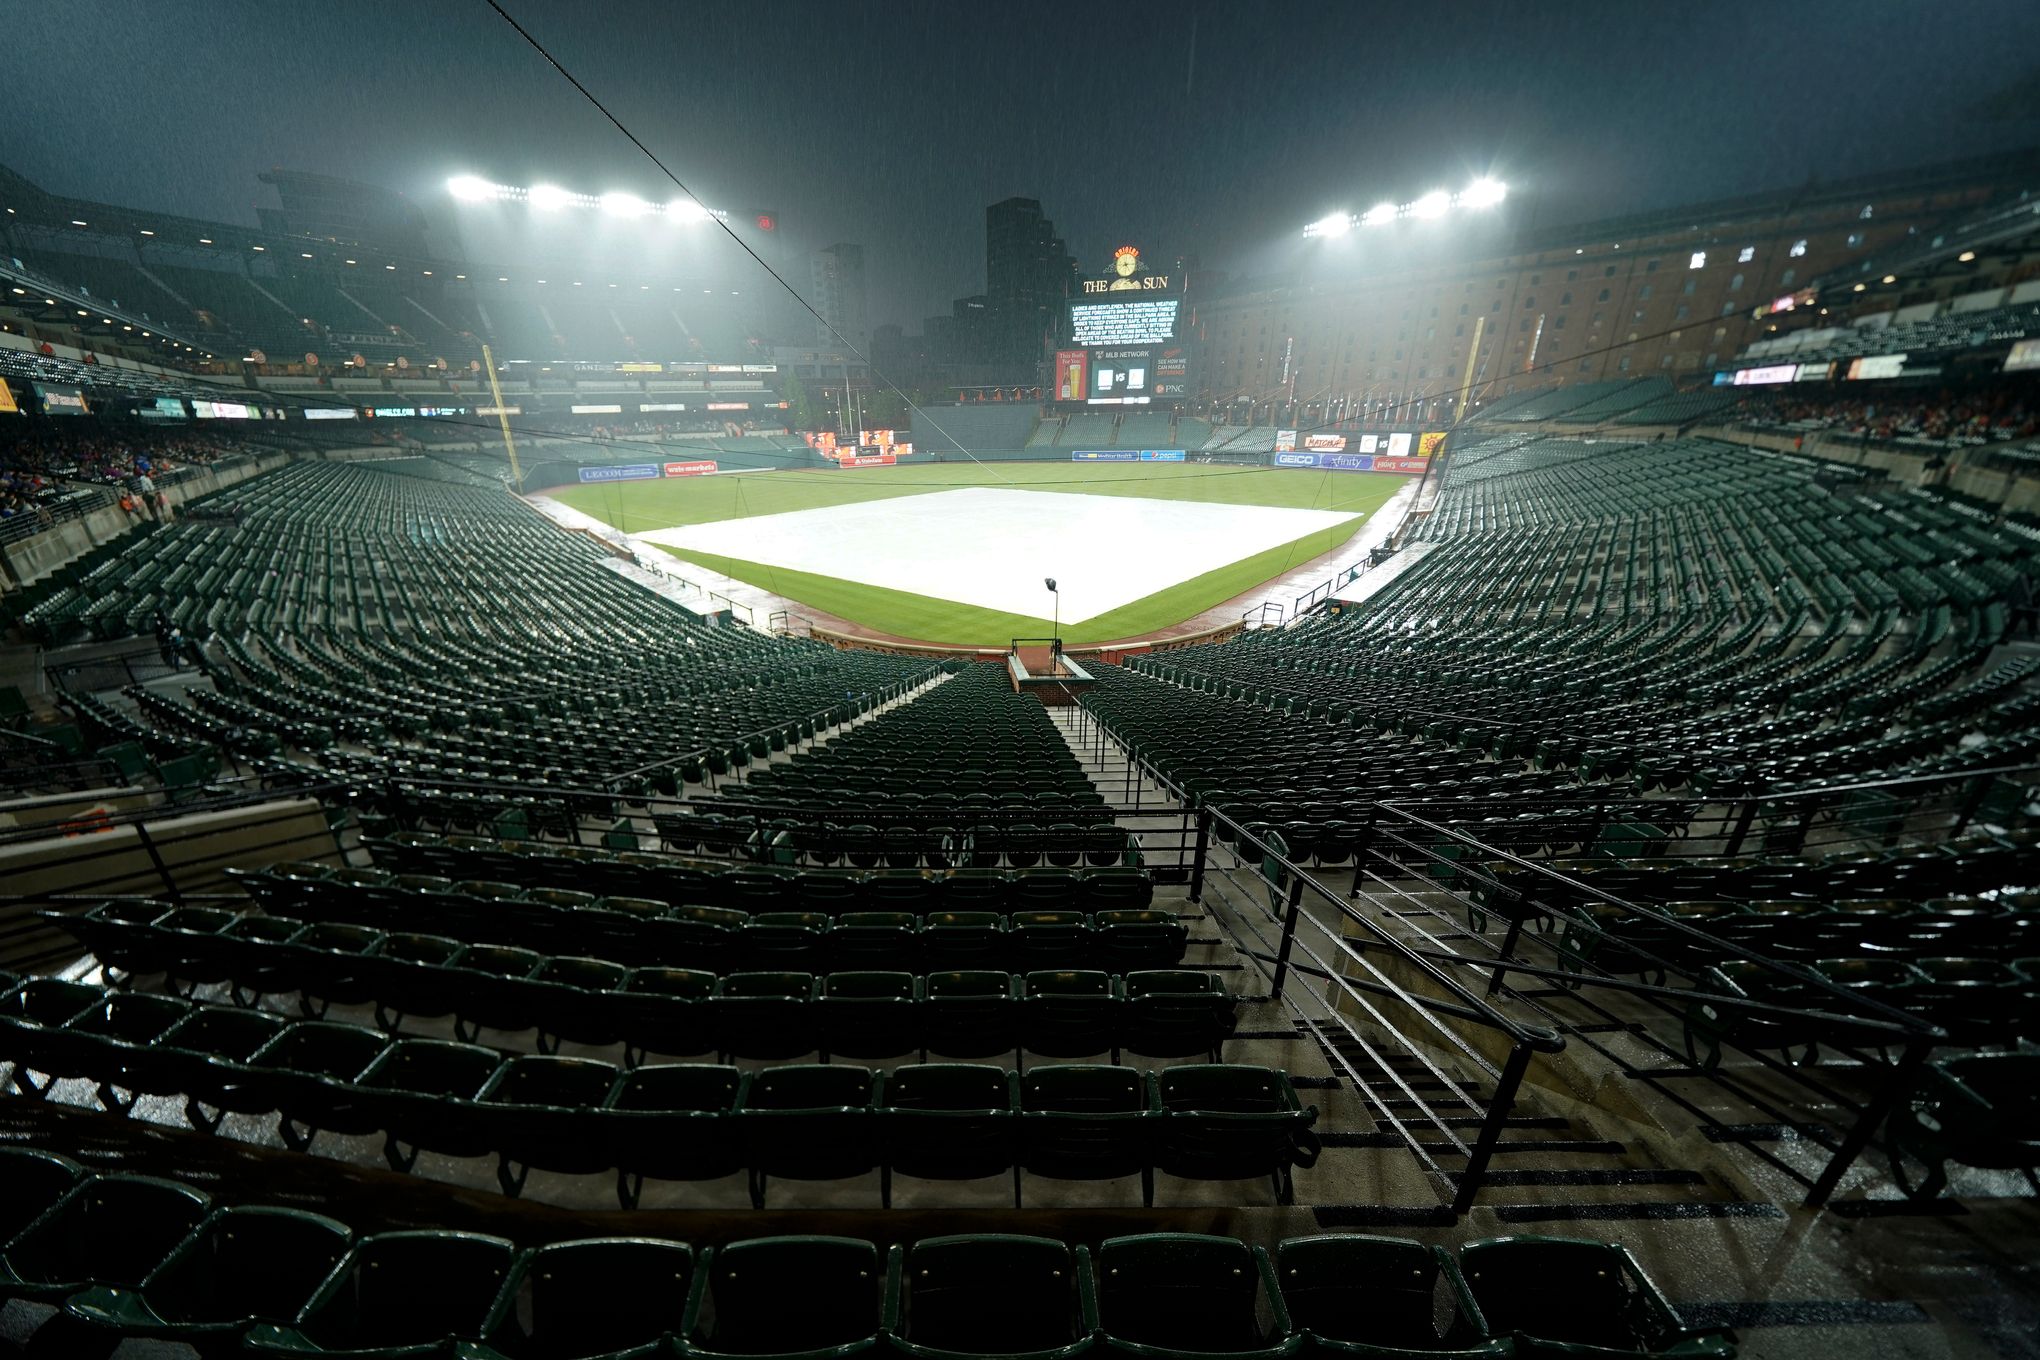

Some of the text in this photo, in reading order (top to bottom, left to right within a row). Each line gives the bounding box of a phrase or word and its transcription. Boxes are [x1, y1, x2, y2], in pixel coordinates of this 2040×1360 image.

[1115, 246, 1139, 258] ORIOLES
[1084, 276, 1168, 292] THE SUN
[1165, 384, 1184, 392] PNC
[1307, 438, 1342, 446] MATCHUP
[1279, 455, 1313, 464] GEICO
[1331, 457, 1362, 468] xfinity
[685, 464, 715, 472] markets
